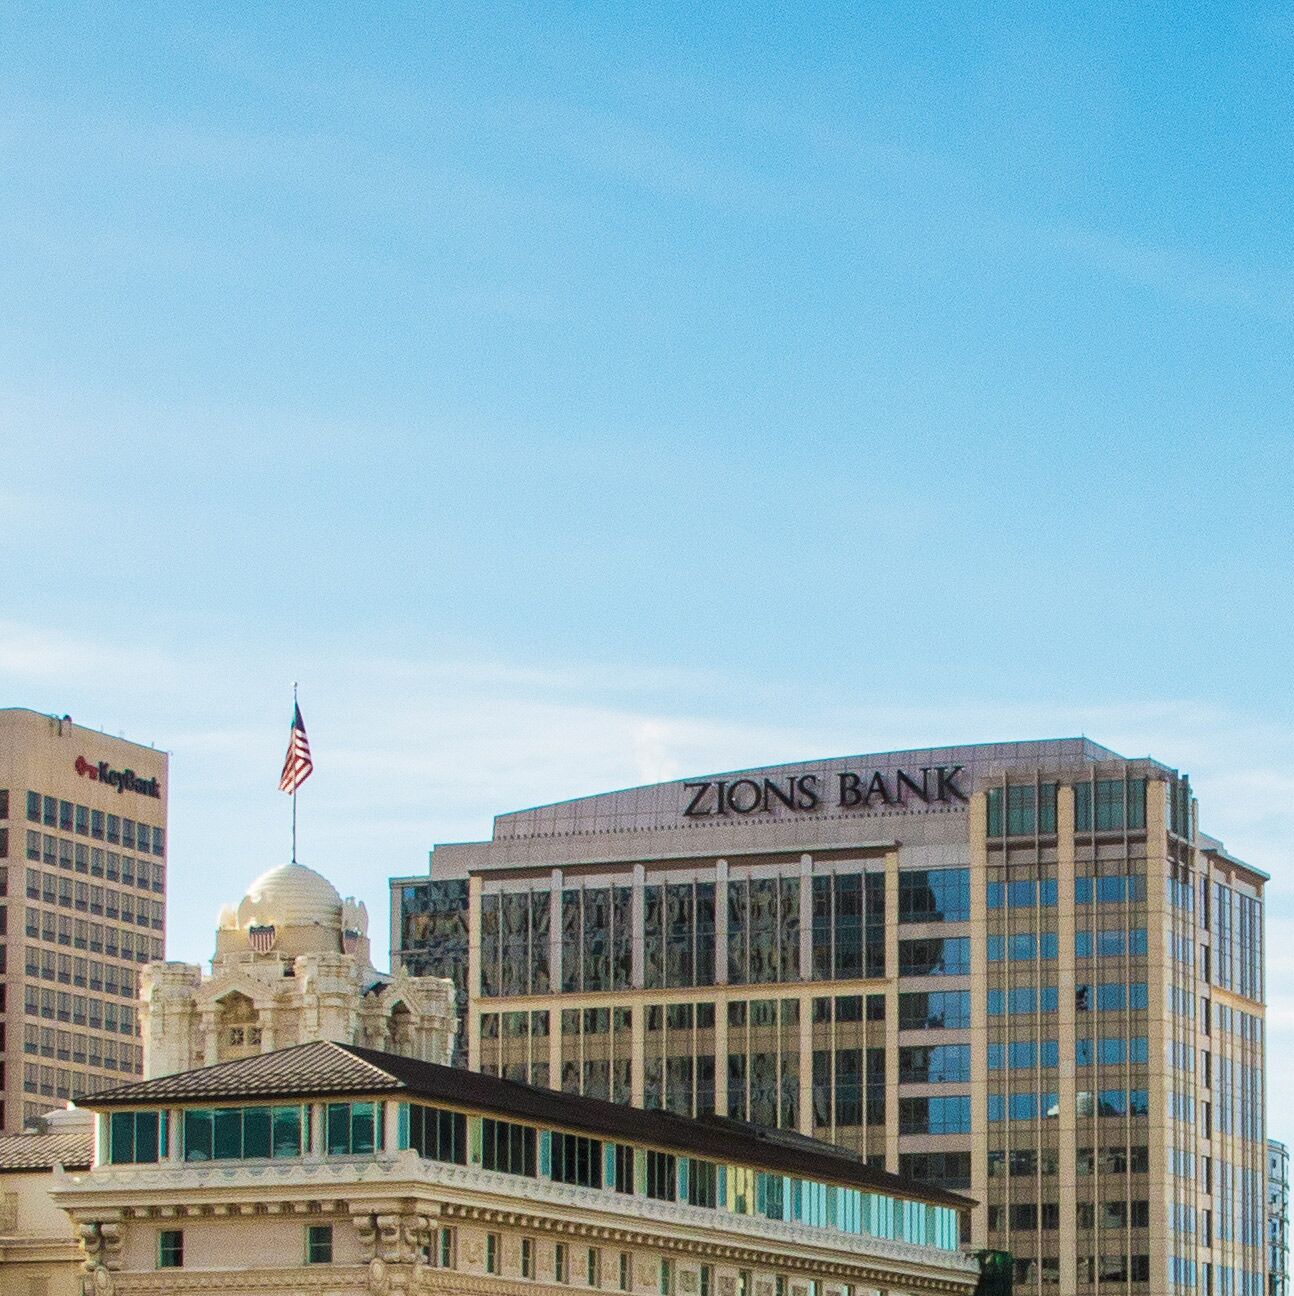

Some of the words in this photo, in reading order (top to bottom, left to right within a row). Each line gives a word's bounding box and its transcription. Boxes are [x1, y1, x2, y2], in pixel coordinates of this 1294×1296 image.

[98, 761, 161, 799] KeyBank
[683, 775, 817, 817] ZIONS
[837, 765, 969, 807] BANK
